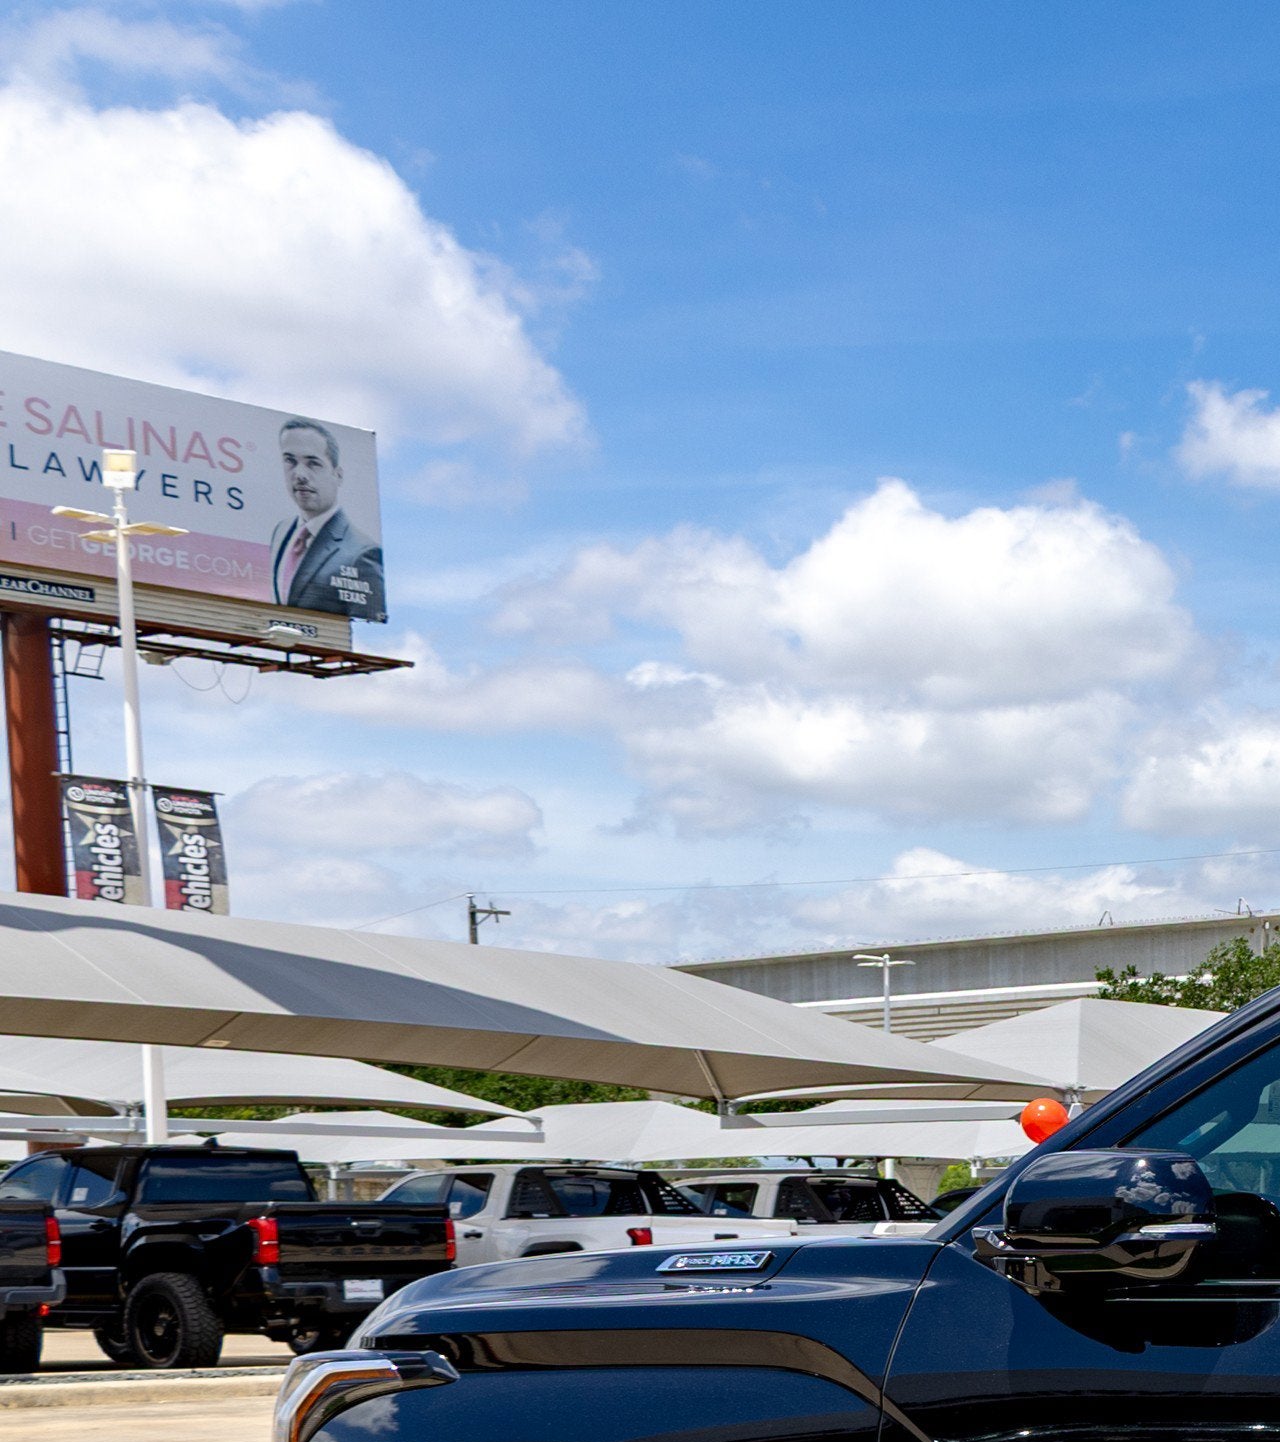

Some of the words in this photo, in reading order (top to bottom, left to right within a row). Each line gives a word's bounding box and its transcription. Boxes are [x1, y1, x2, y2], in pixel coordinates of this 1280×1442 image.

[24, 396, 245, 474] SALINAS
[8, 443, 245, 511] LAWYERS
[0, 577, 94, 601] EARCHANNEL
[337, 589, 368, 606] TEXAS
[339, 564, 359, 578] SAN
[90, 822, 124, 903] ehicles
[178, 833, 214, 914] ehicles
